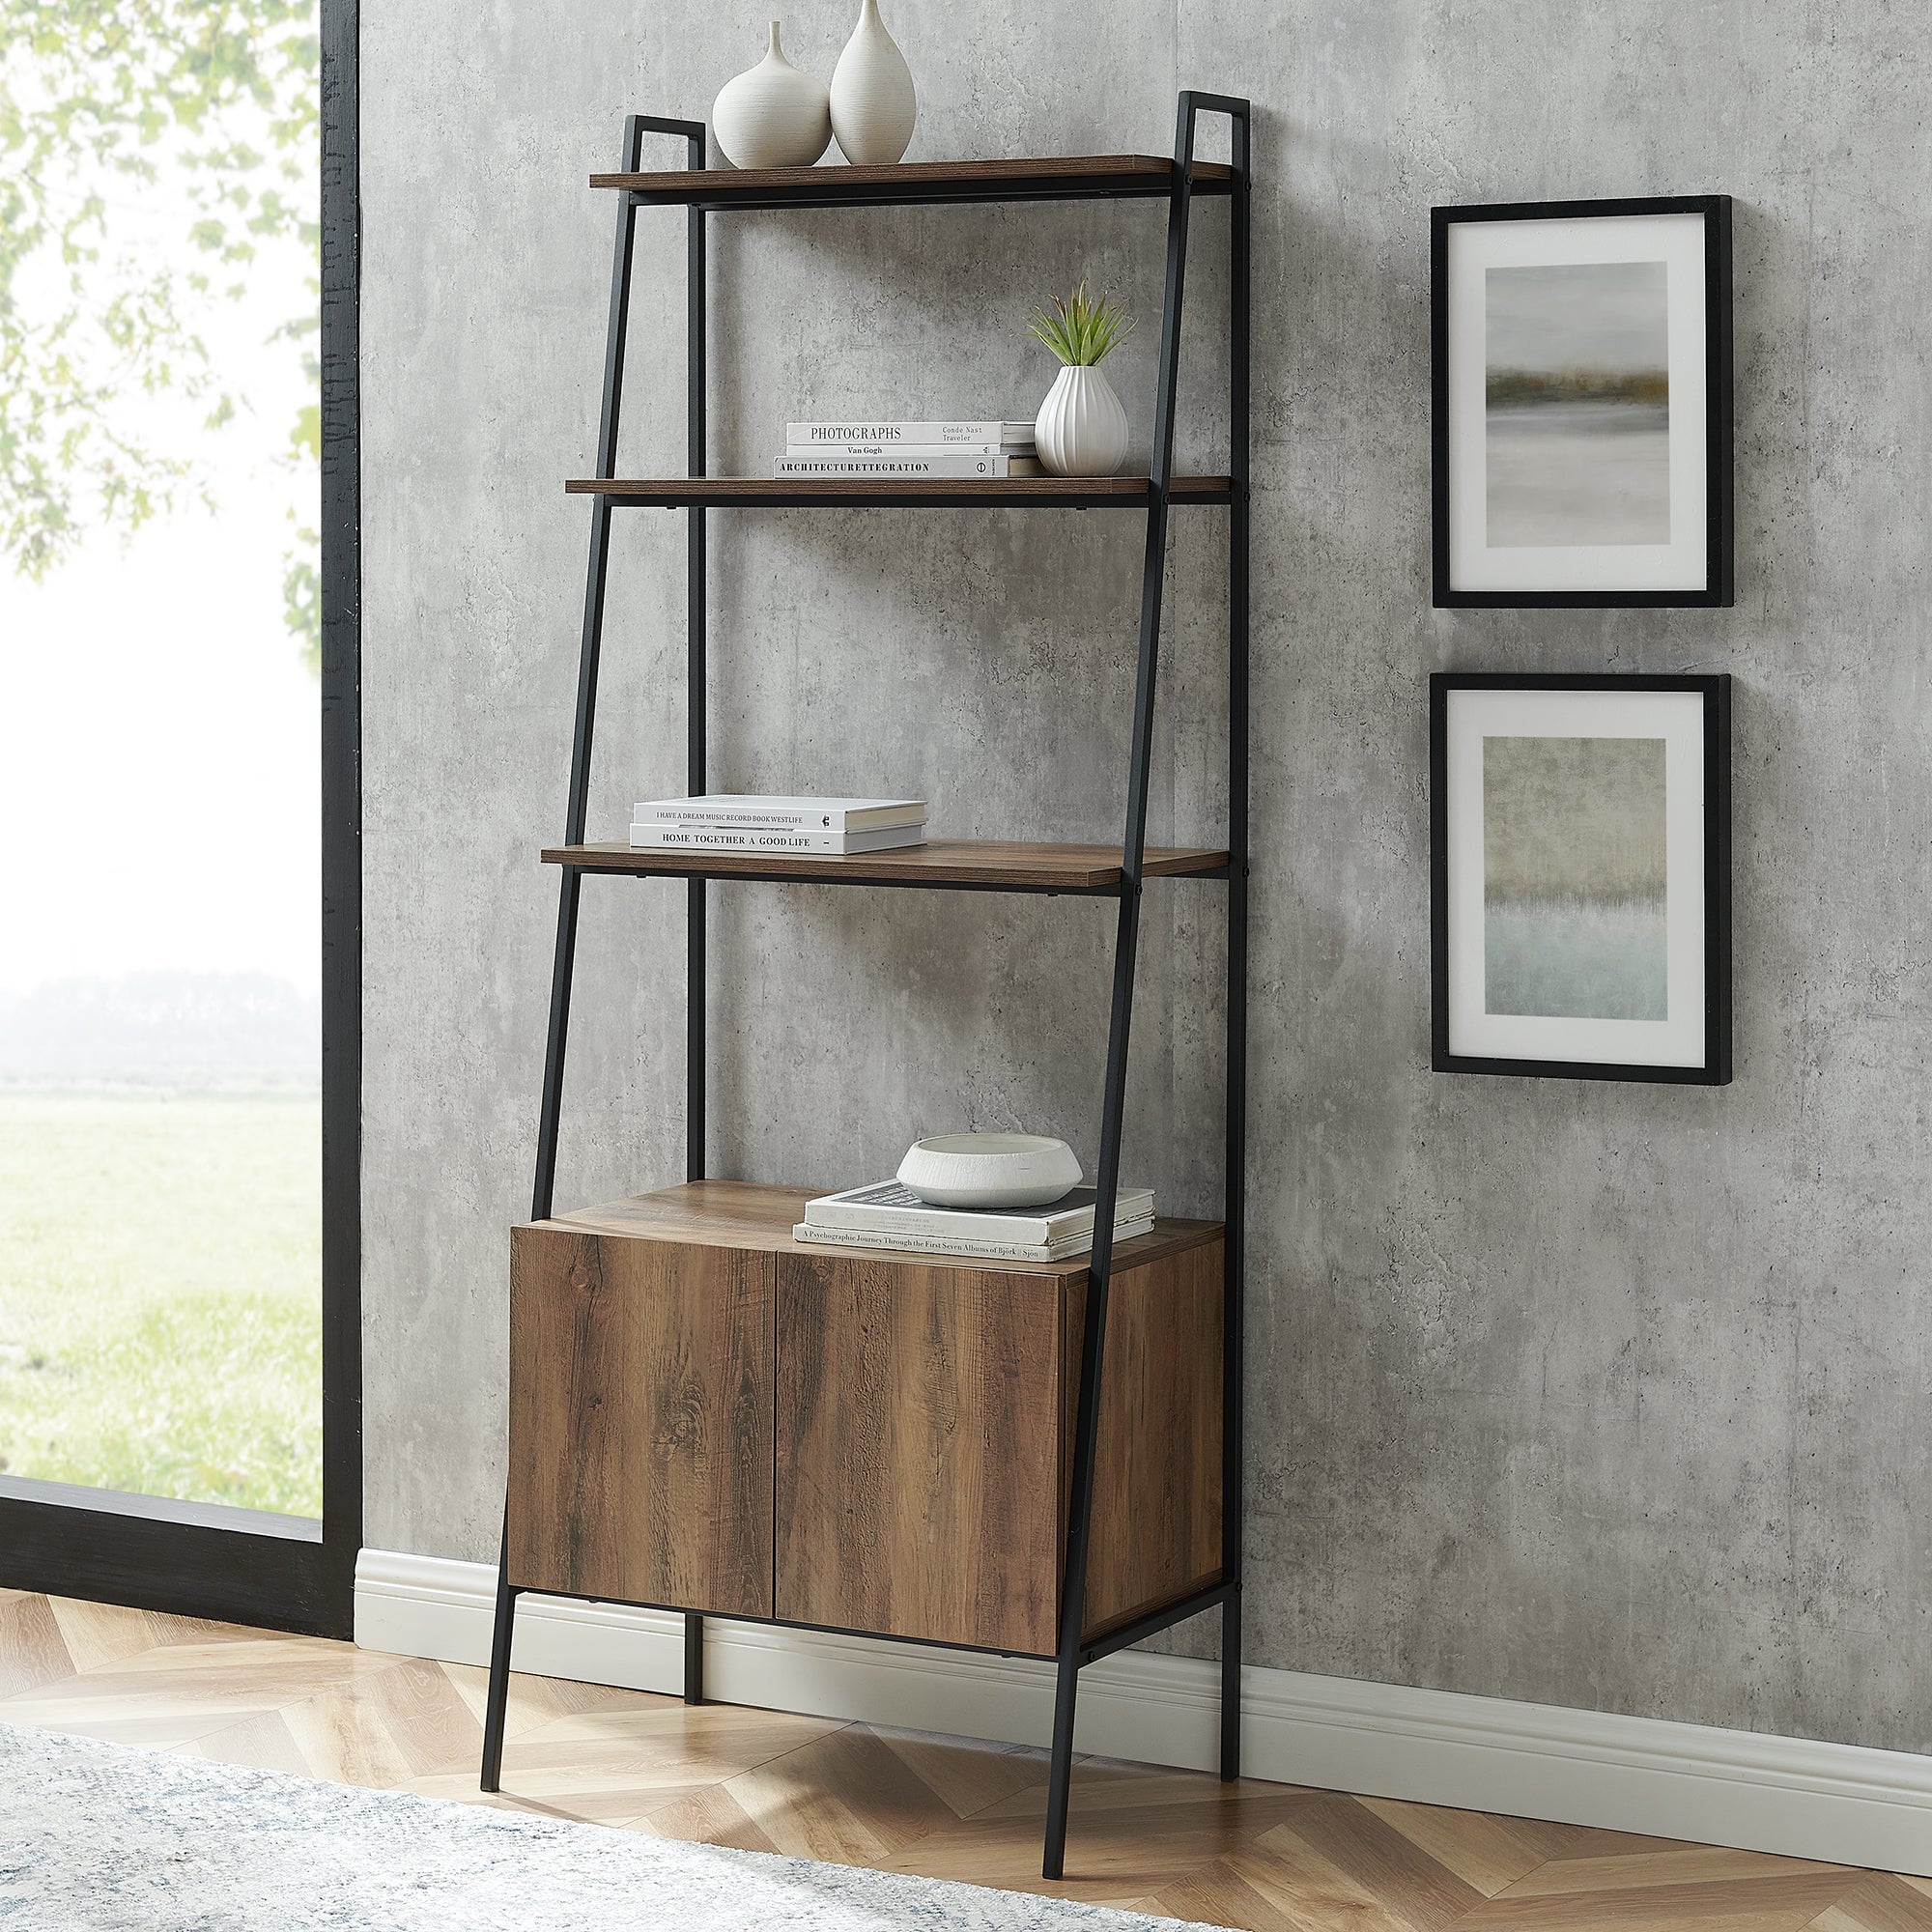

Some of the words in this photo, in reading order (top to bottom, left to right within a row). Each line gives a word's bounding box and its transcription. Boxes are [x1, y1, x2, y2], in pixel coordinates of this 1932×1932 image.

[810, 427, 901, 440] PHOTOGRAPHS
[864, 446, 883, 455] Gogh
[780, 463, 930, 472] ARCHITECTURETTEGRATION
[771, 815, 803, 824] WESTLIFE
[662, 834, 691, 842] HOME
[693, 834, 745, 844] TOGETHER
[758, 837, 787, 846] GOOD
[788, 838, 810, 846] LIFE
[809, 1230, 856, 1242] Psychographic
[856, 1235, 883, 1245] Journey
[883, 1236, 912, 1248] Through
[924, 1240, 941, 1249] First
[942, 1242, 962, 1251] Seven
[963, 1244, 989, 1253] Albums
